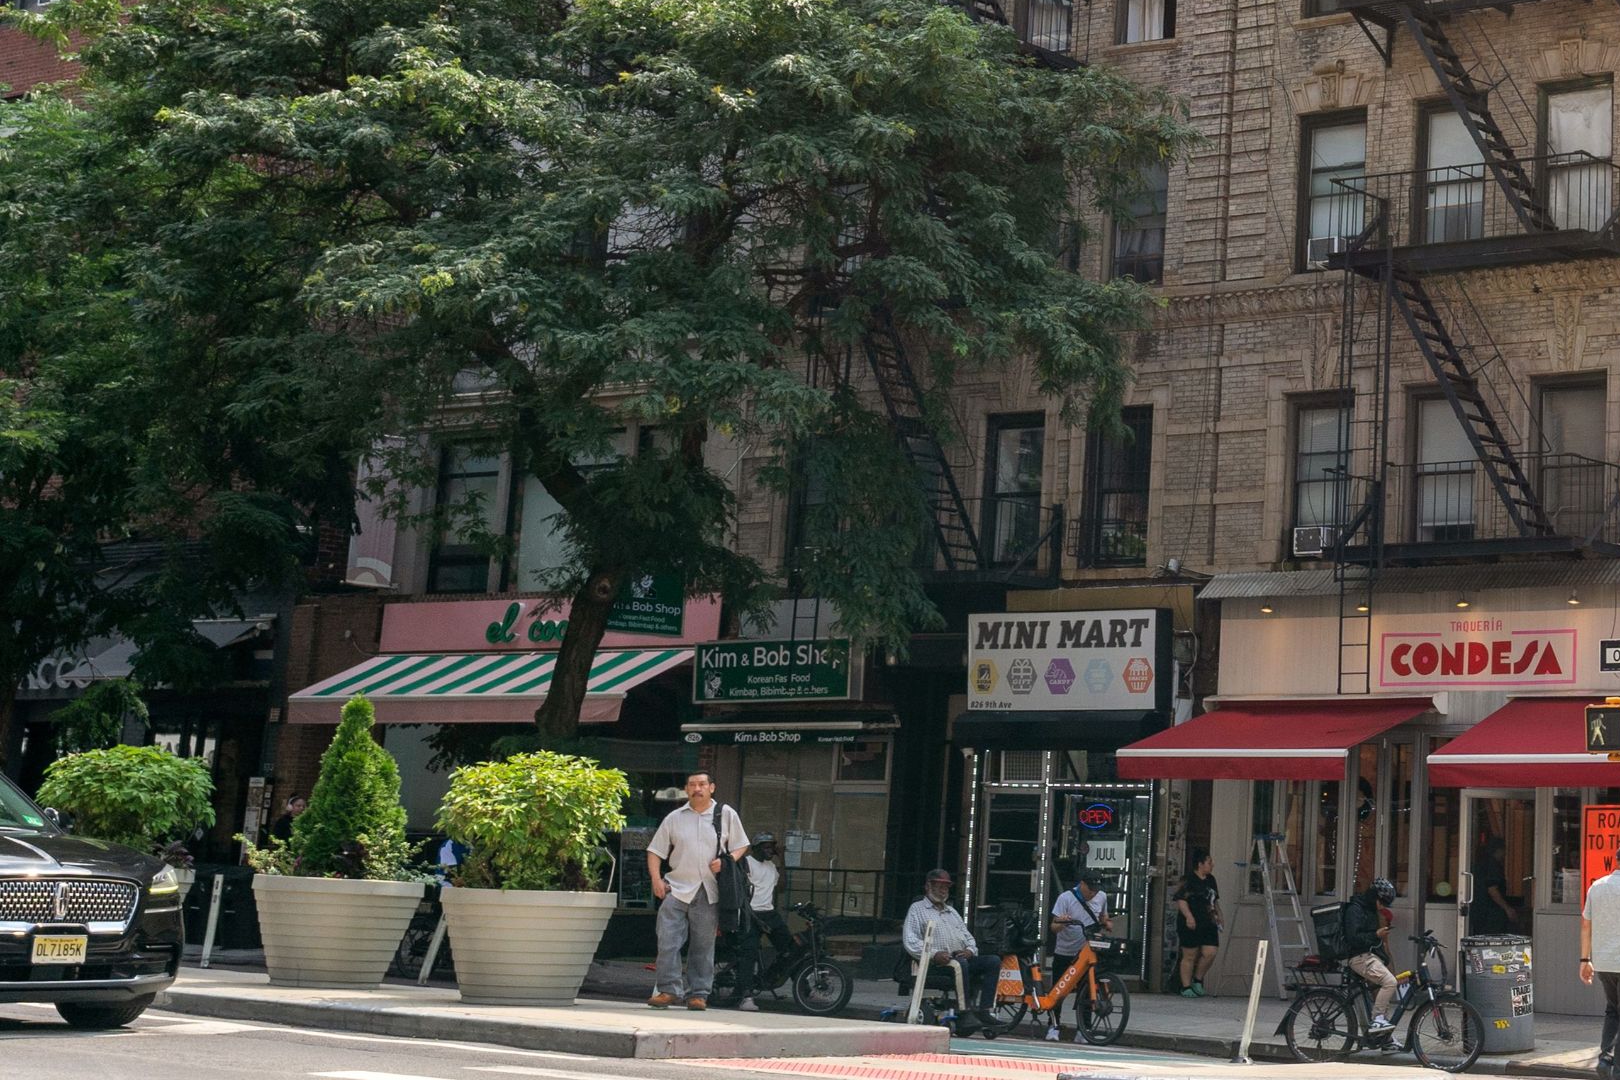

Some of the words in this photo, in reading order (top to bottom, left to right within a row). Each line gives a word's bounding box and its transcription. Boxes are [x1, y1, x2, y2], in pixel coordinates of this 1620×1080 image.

[632, 601, 653, 612] Bob
[655, 604, 681, 616] Shop
[485, 602, 521, 643] el
[975, 621, 1050, 649] MINI
[1057, 618, 1150, 648] MART
[702, 647, 737, 668] Kim
[741, 653, 749, 666] &
[753, 645, 791, 667] Bob
[1391, 640, 1562, 676] CONDESA
[747, 674, 774, 684] Korean
[774, 674, 788, 683] Fas
[791, 673, 811, 682] Food
[985, 700, 997, 709] 9th
[998, 701, 1012, 709] Ave
[734, 732, 752, 742] Kim
[758, 732, 777, 742] Bob
[778, 732, 801, 743] Shop
[1079, 809, 1113, 824] OPEN
[1588, 834, 1604, 850] TO
[1094, 847, 1116, 861] JUUL
[1604, 856, 1613, 871] W
[36, 943, 83, 957] DL7185K
[1055, 967, 1077, 995] JOCO
